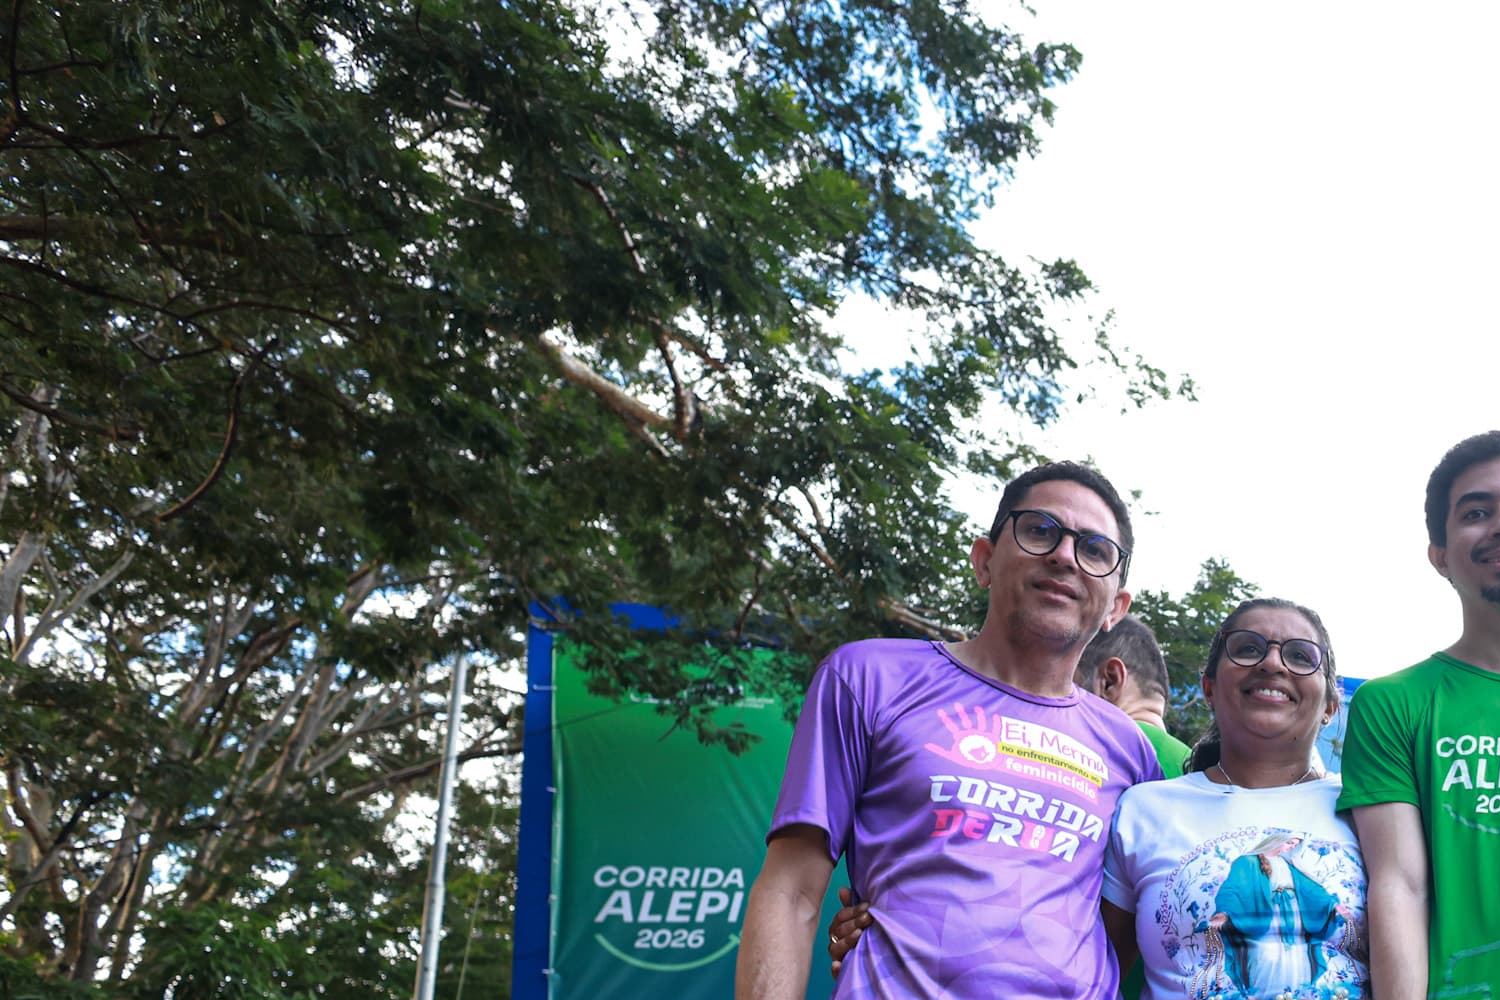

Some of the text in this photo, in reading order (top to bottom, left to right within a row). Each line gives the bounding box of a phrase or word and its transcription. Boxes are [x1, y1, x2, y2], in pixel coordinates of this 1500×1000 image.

[1001, 745, 1015, 754] no
[593, 865, 745, 889] CORRIDA
[593, 890, 745, 924] ALEPI
[634, 928, 705, 950] 2026
